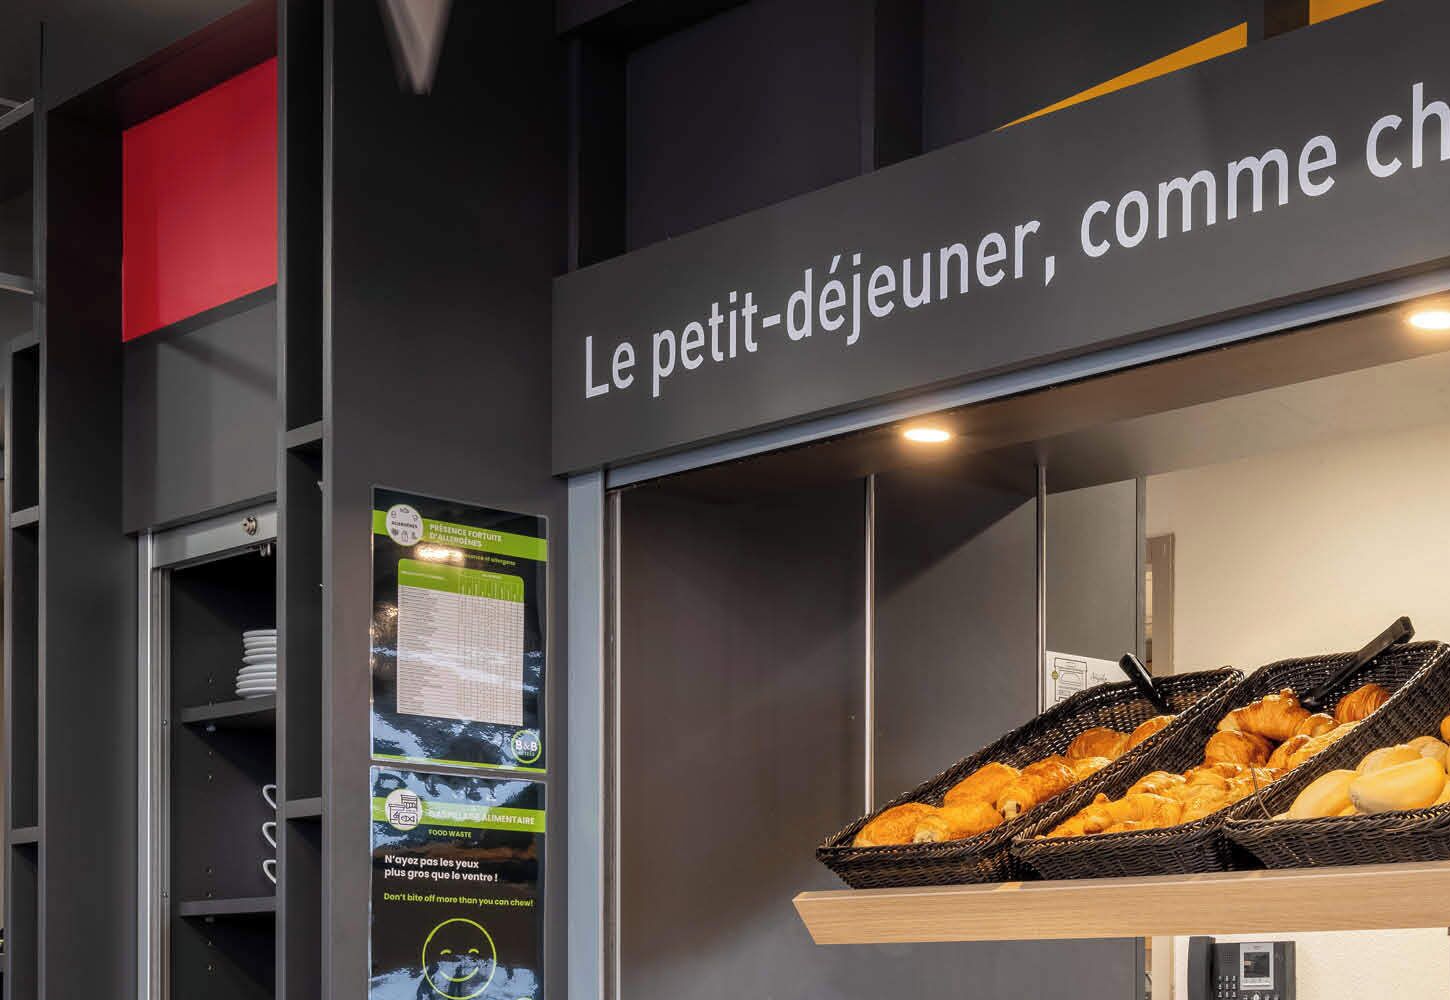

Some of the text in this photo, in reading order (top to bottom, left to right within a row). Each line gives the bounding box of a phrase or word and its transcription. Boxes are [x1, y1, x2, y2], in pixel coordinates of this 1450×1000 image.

[585, 334, 636, 399] Le
[652, 219, 1056, 398] petit-déjeuner,
[1080, 134, 1337, 258] comme
[467, 529, 502, 542] FORTUITE
[515, 739, 538, 752] B&B
[480, 812, 535, 825] ALIMENTAIRE
[428, 829, 472, 839] FOOD WASTE
[384, 854, 480, 870] N'ayez pas les yeux
[384, 868, 406, 879] plus
[408, 869, 430, 881] gros
[432, 871, 451, 882] que
[452, 871, 460, 880] le
[461, 873, 494, 882] ventre
[383, 892, 407, 901] Don't
[407, 893, 424, 902] bite
[424, 894, 436, 902] off
[459, 895, 478, 904] than
[479, 898, 494, 907] you
[510, 899, 534, 907] chew!
